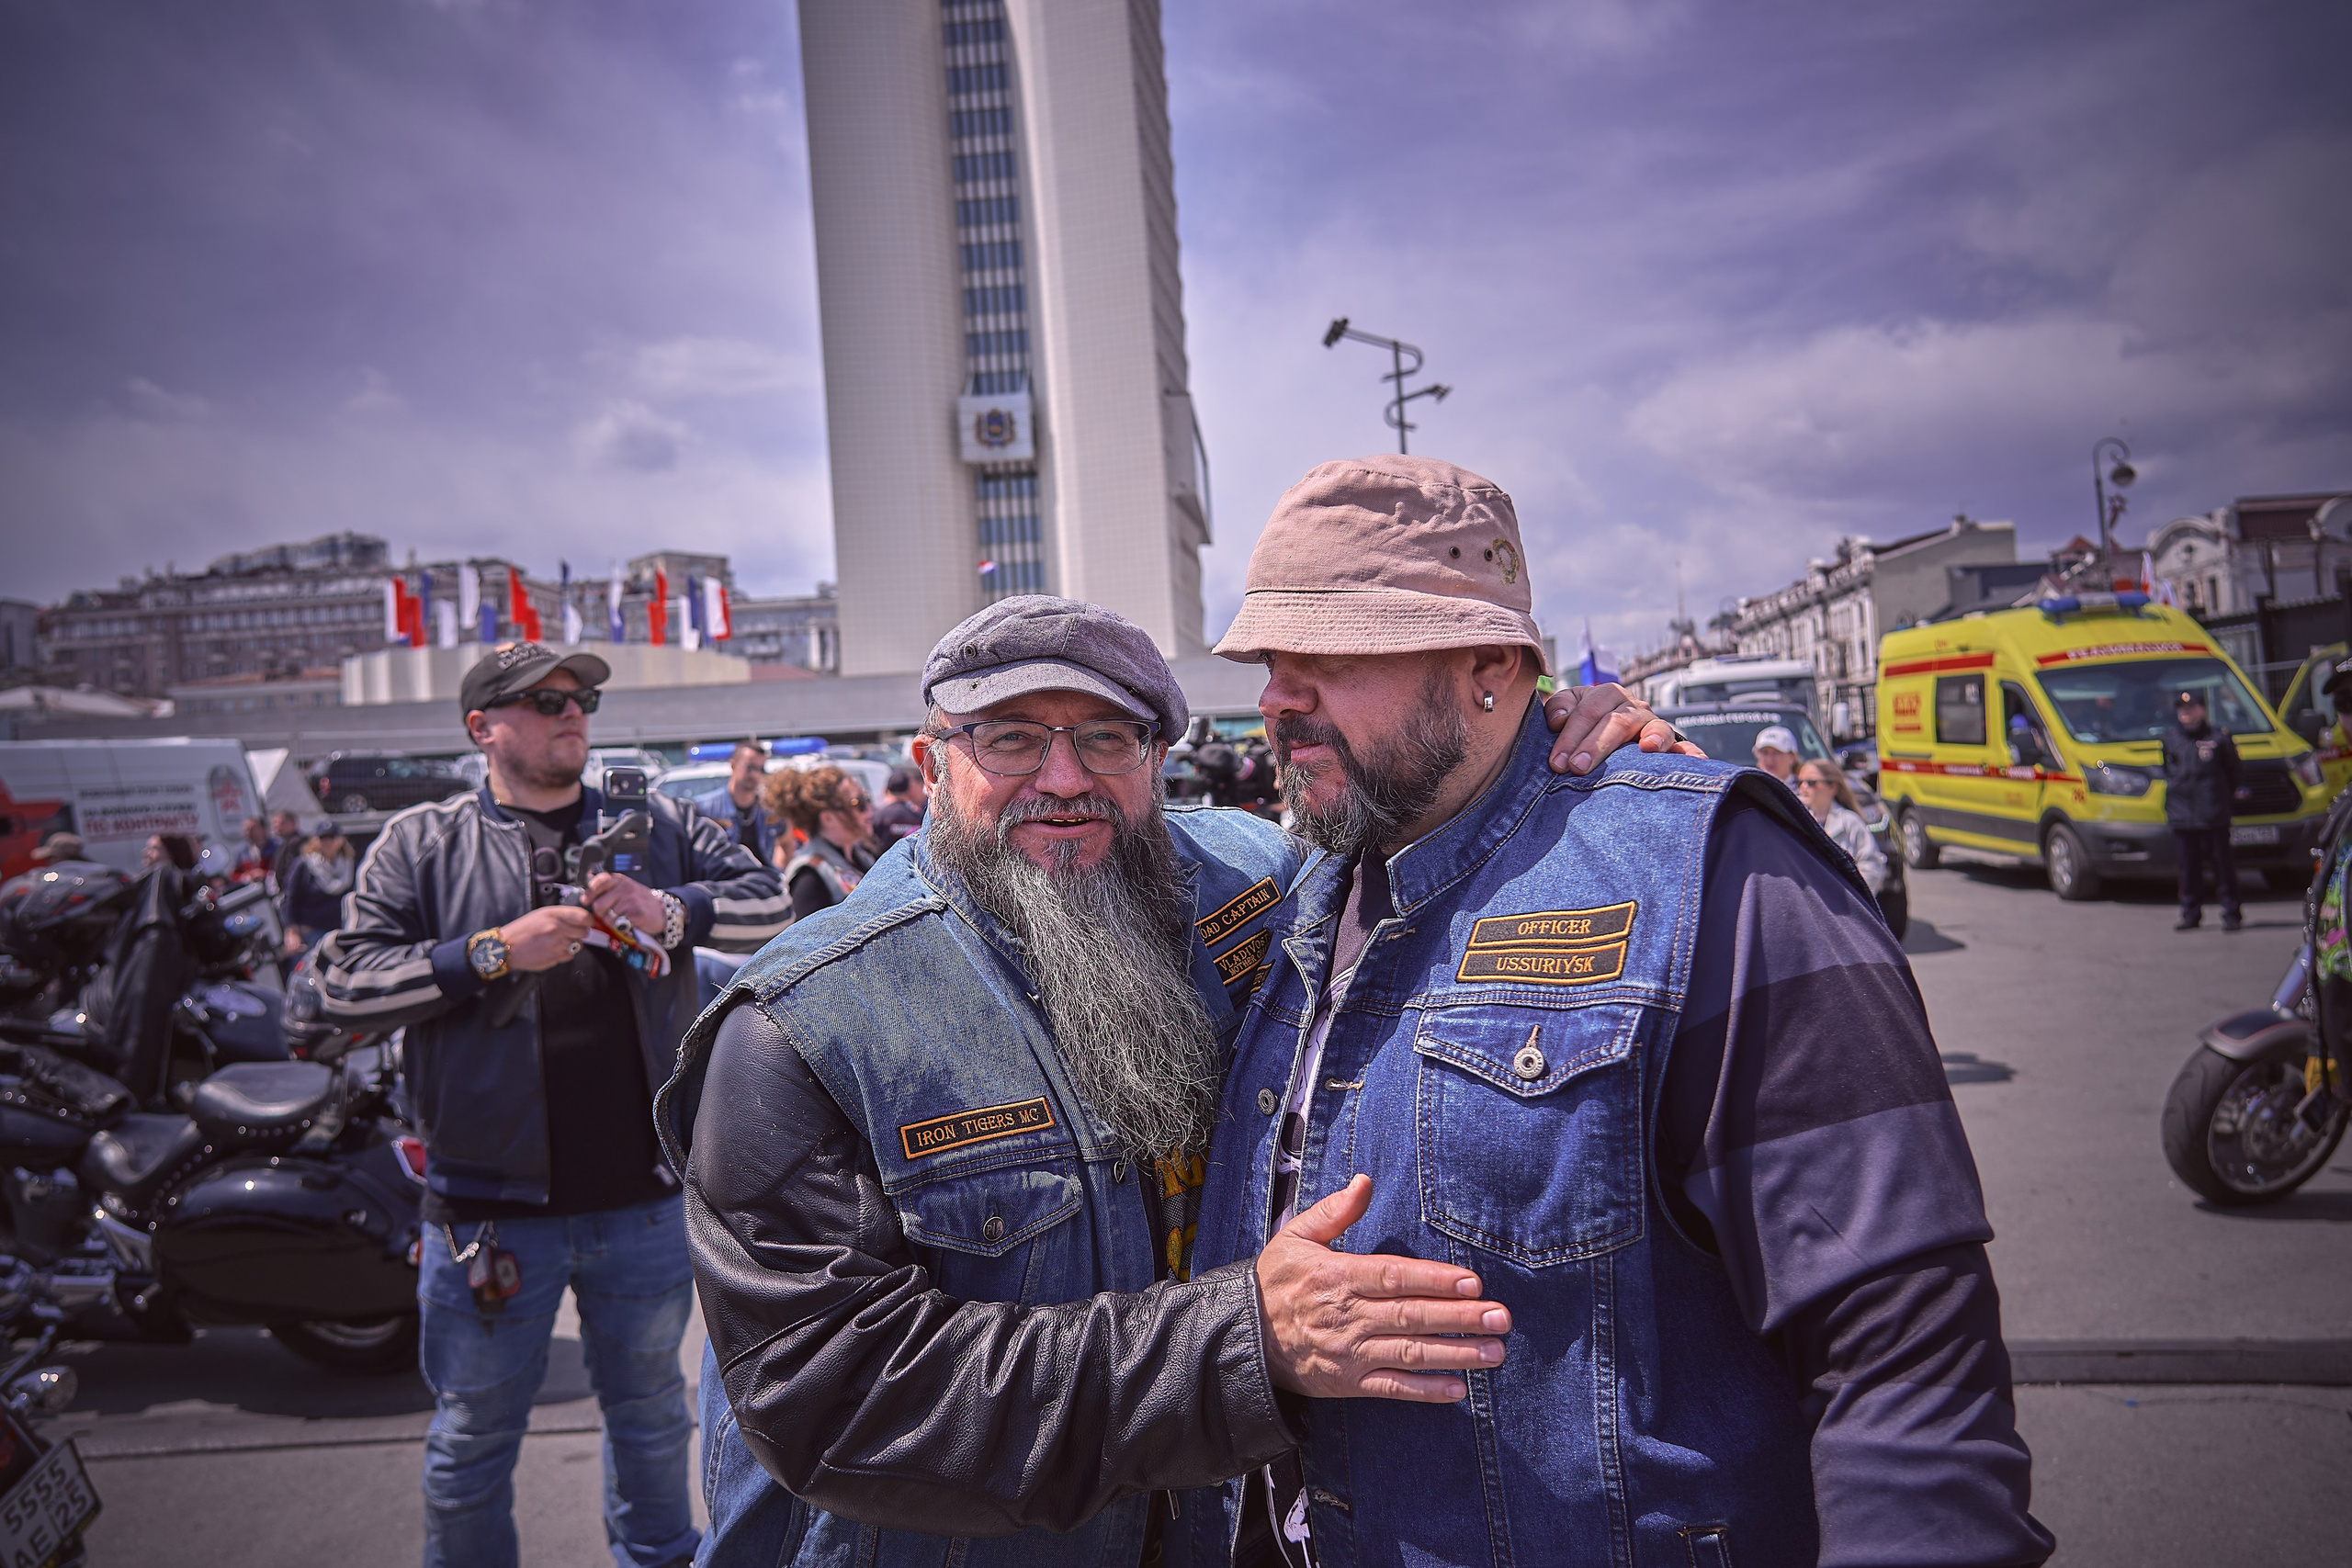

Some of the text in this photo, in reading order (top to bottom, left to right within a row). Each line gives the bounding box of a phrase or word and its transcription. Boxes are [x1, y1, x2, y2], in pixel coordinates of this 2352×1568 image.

[1199, 888, 1271, 940] OAD CAPTAIN
[1518, 919, 1591, 935] OFFICER
[1219, 933, 1269, 971] VLADIVOST
[1228, 955, 1258, 976] MOTHER
[1496, 955, 1595, 974] USSURIYSK
[916, 1108, 1040, 1146] IRON TIGERS MC
[6, 1459, 66, 1536] 5555
[55, 1485, 86, 1529] 25
